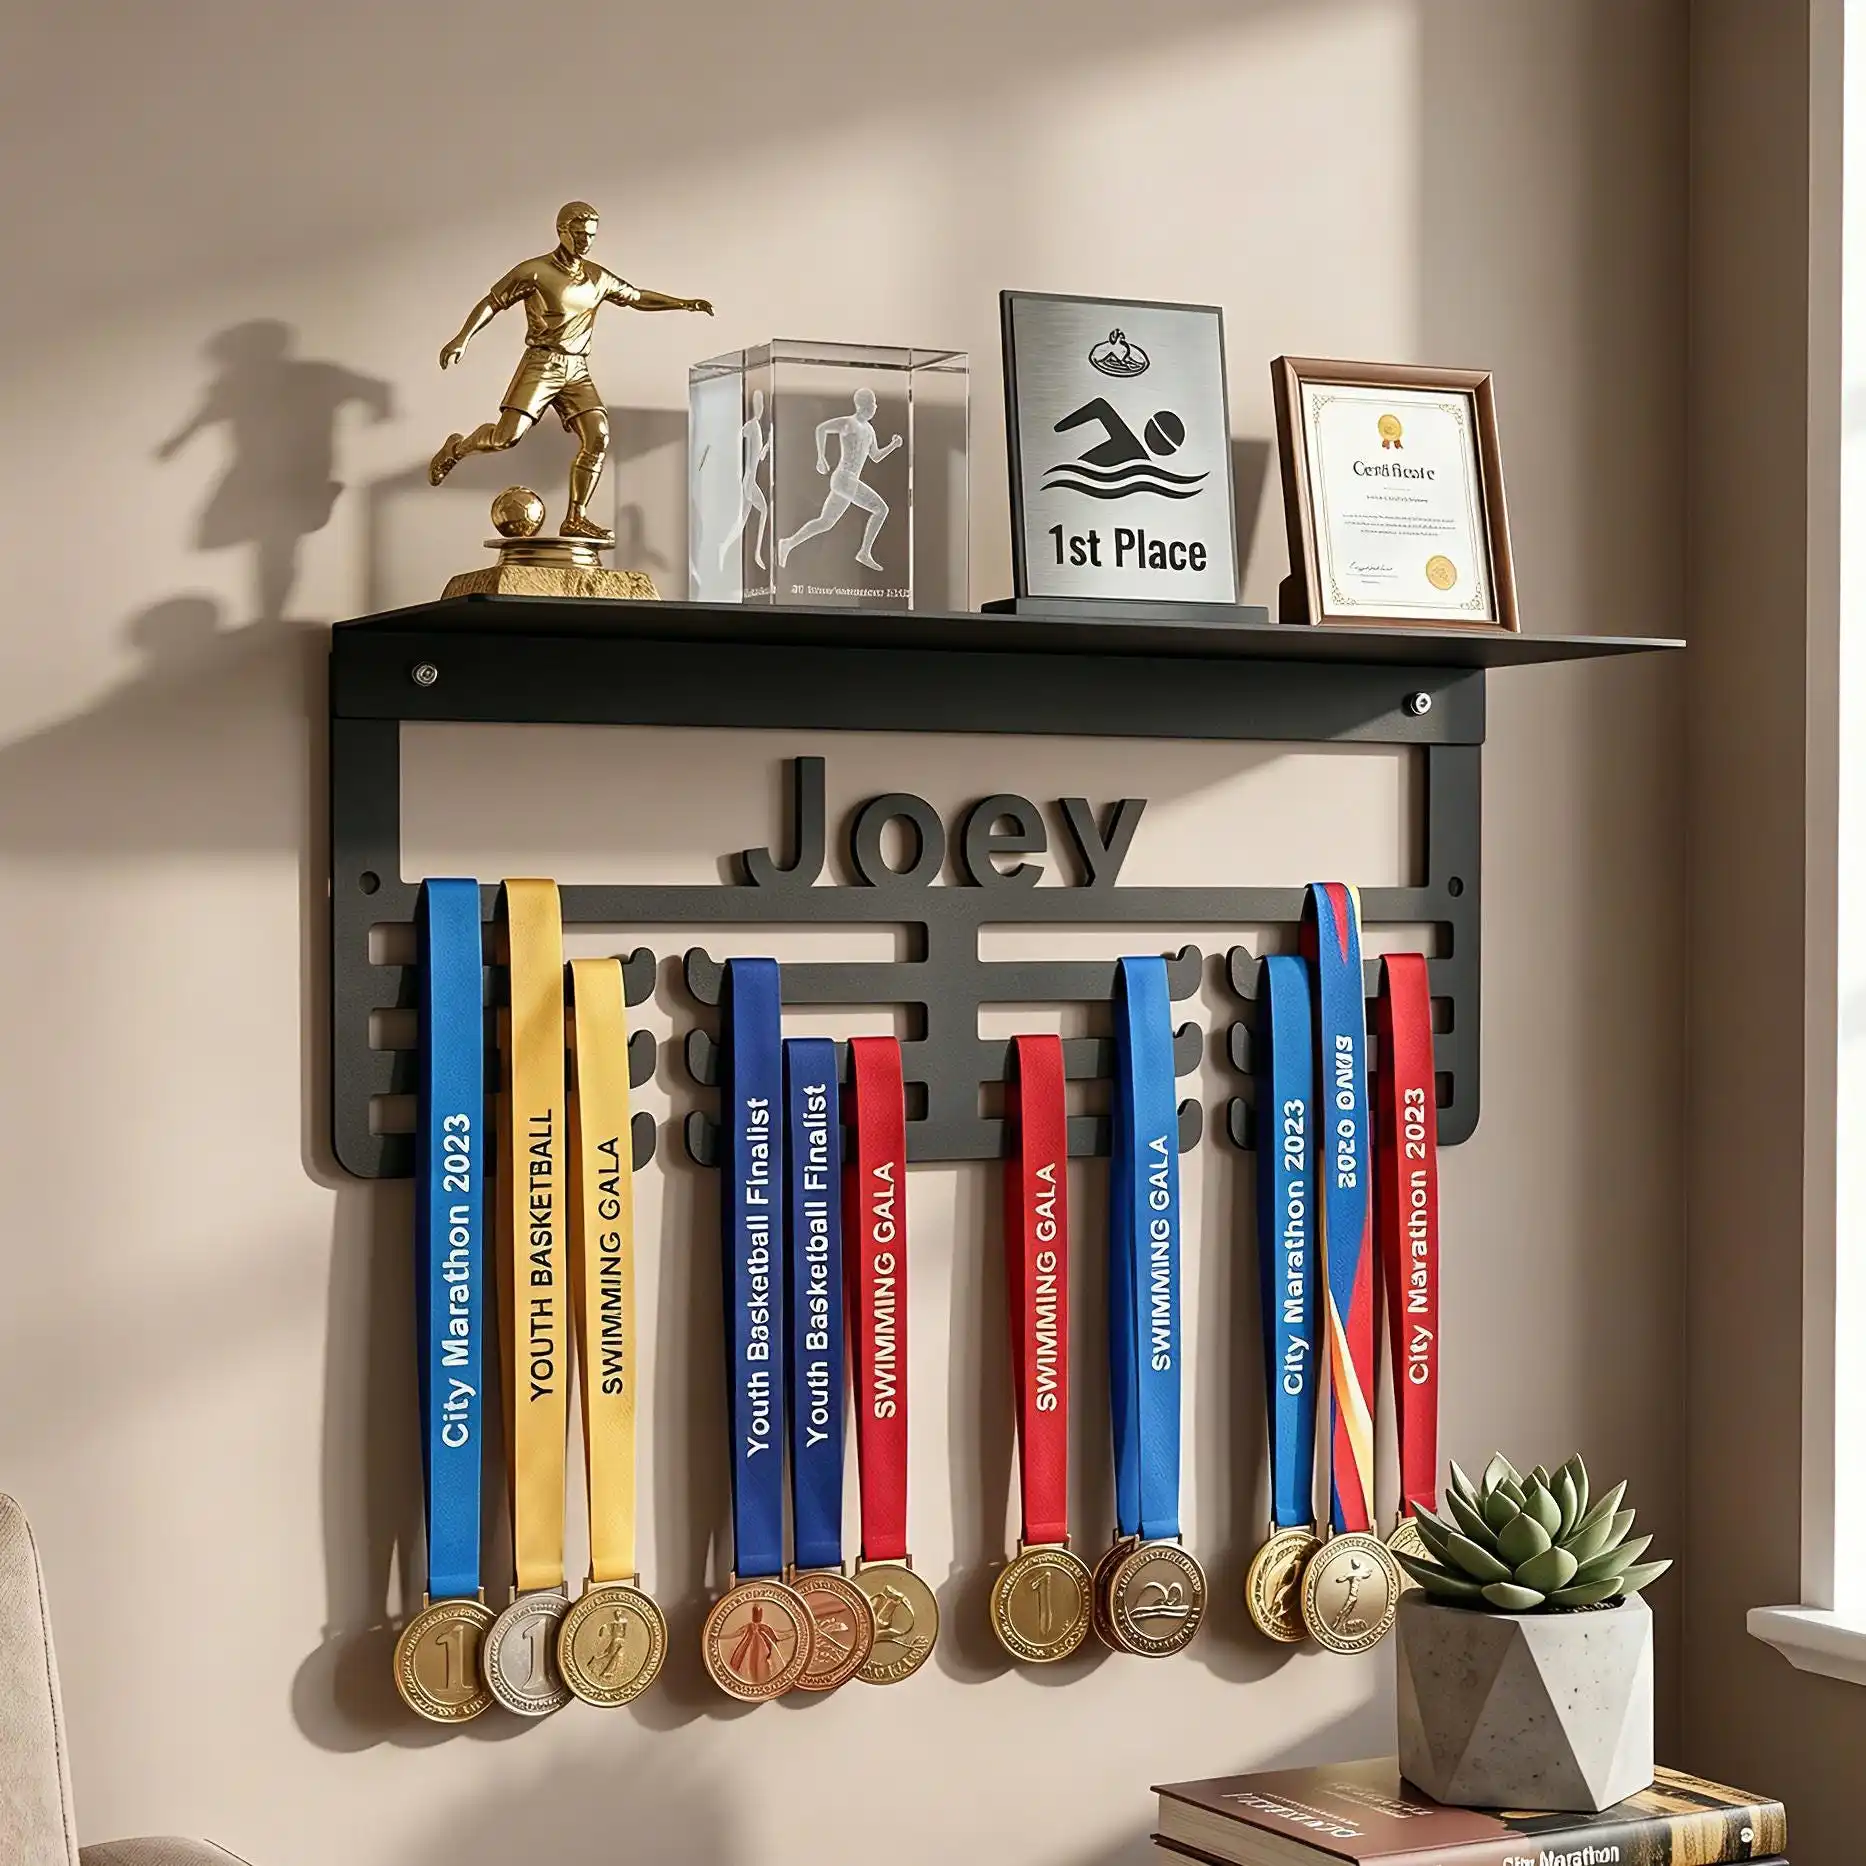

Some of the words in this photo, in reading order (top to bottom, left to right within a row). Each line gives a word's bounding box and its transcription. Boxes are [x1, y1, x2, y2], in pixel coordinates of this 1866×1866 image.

[1048, 523, 1103, 567] 1st
[1114, 527, 1208, 571] Place
[743, 756, 1148, 888] Joey
[442, 1112, 472, 1193] 2023
[746, 1097, 770, 1205] Finalist
[803, 1083, 828, 1191] Finalist
[1283, 1098, 1306, 1172] 2023
[1404, 1086, 1426, 1161] 2023
[529, 1107, 554, 1287] BASKETBALL
[597, 1136, 621, 1221] GALA
[872, 1160, 896, 1244] GALA
[1034, 1162, 1057, 1243] GALA
[1148, 1134, 1171, 1212] GALA
[804, 1201, 829, 1351] Basketball
[1283, 1179, 1305, 1324] Marathon
[1407, 1169, 1429, 1313] Marathon
[441, 1203, 471, 1368] Marathon
[600, 1232, 624, 1396] SWIMMING
[746, 1214, 770, 1362] Basketball
[1150, 1218, 1171, 1372] SWIMMING
[530, 1298, 554, 1403] YOUTH
[873, 1251, 897, 1419] SWIMMING
[1035, 1250, 1059, 1413] SWIMMING
[1283, 1334, 1311, 1396] City
[1408, 1324, 1435, 1385] City
[441, 1376, 477, 1449] City
[747, 1370, 770, 1459] Youth
[806, 1361, 829, 1448] Youth
[1031, 1571, 1053, 1636] 1
[434, 1624, 474, 1692] 1
[521, 1617, 549, 1691] 1
